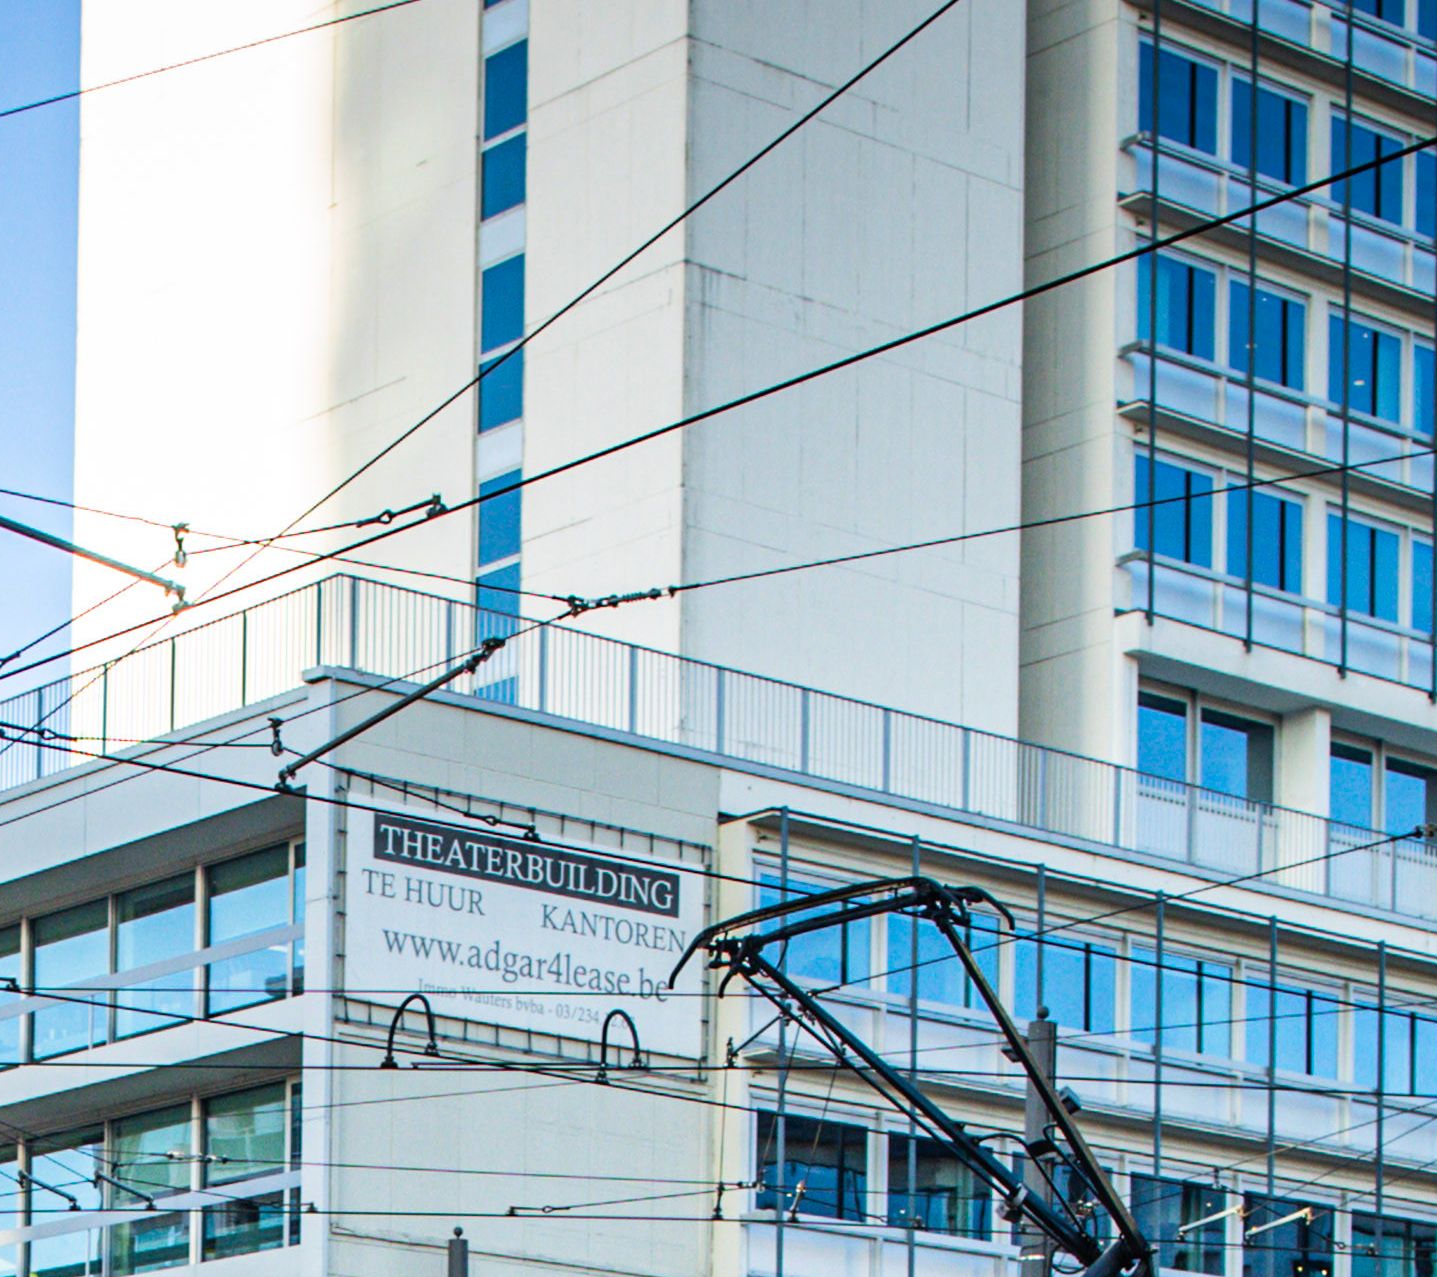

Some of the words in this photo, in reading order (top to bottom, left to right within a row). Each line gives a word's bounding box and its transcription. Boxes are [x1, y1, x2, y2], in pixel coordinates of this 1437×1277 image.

[380, 824, 674, 909] THEATERBUILDING
[362, 868, 396, 898] TE
[405, 876, 485, 916] HUUR
[540, 903, 686, 953] KANTOREN
[382, 928, 670, 1002] www.adgar4lease.be
